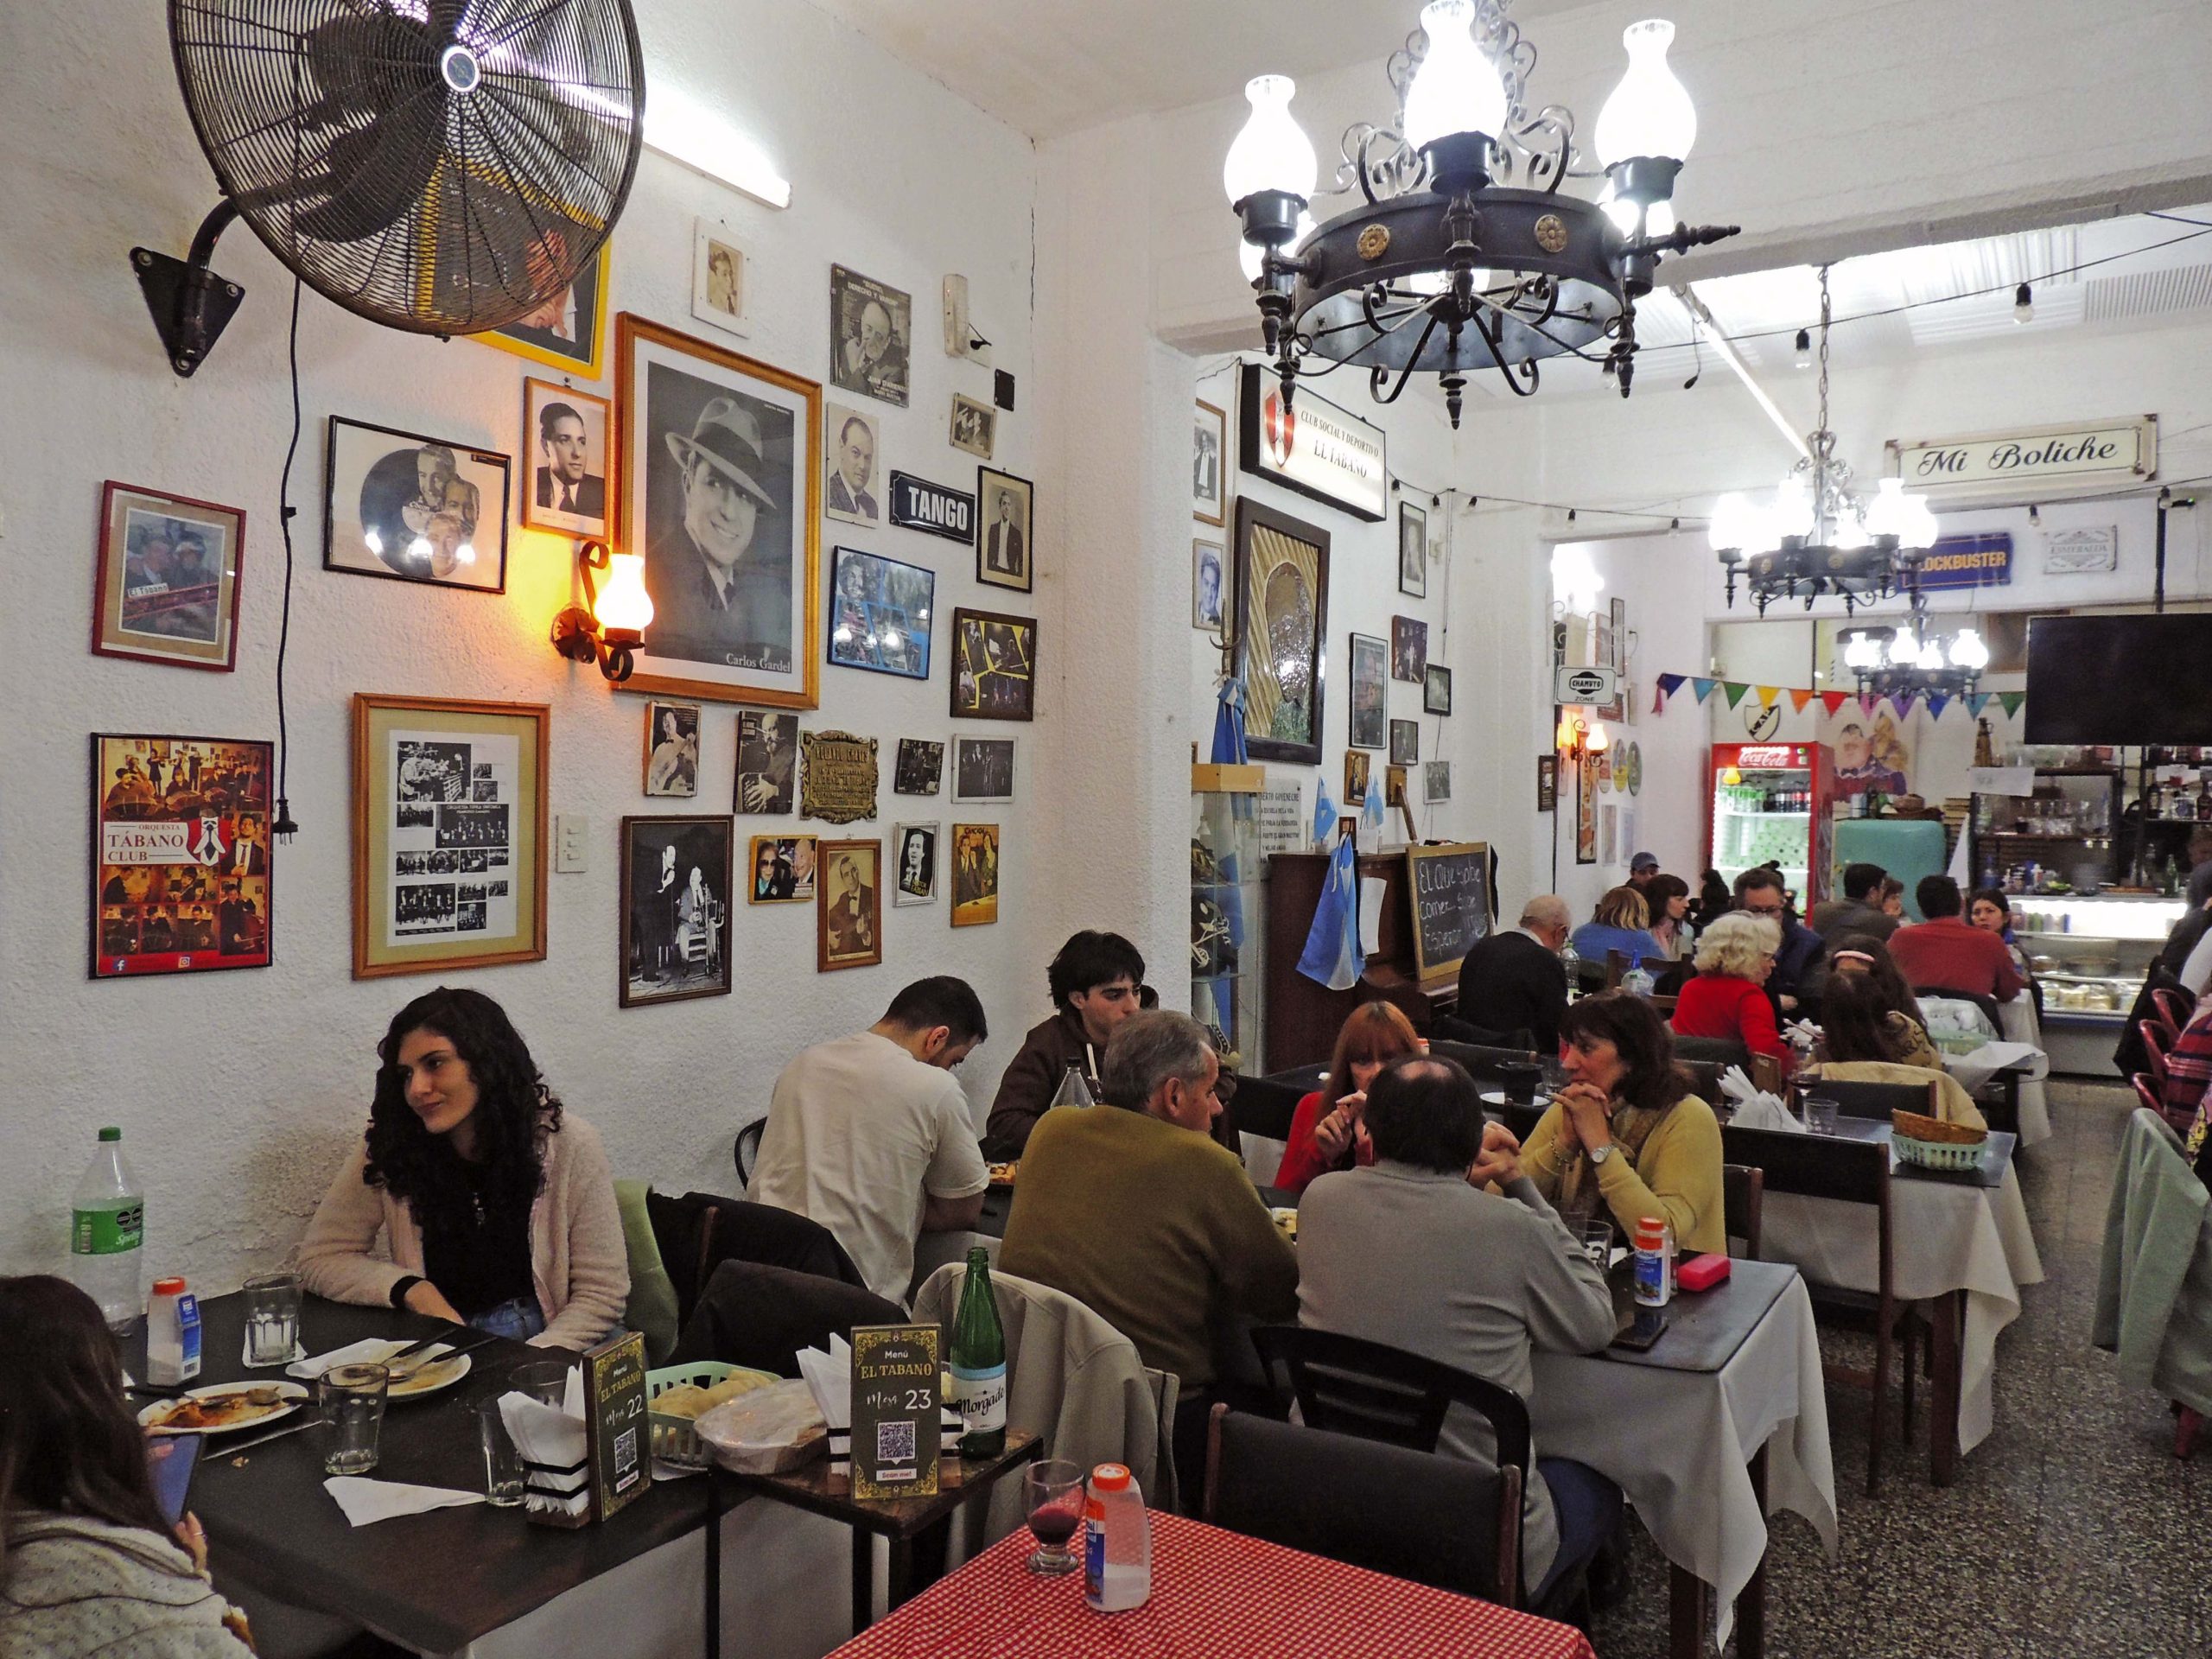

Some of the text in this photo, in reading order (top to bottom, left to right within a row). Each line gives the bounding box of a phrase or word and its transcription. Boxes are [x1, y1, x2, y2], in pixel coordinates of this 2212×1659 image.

[1300, 410, 1379, 458] CLUB SOCIAL Y DEPORTIVO
[1917, 435, 2119, 477] Mi Boliche
[908, 486, 968, 531] TANGO
[1920, 551, 2006, 572] OCKBUSTER
[726, 652, 791, 672] Carlos Gardel
[107, 830, 184, 848] TÁBANO
[107, 850, 148, 861] CLUB
[884, 1350, 909, 1359] Menú
[613, 1363, 628, 1378] Menú
[861, 1363, 932, 1379] EL TABANO
[601, 1370, 641, 1403] EL TABANO
[627, 1394, 644, 1420] 22
[867, 1389, 932, 1410] Mesa 23
[881, 1471, 899, 1479] Scan
